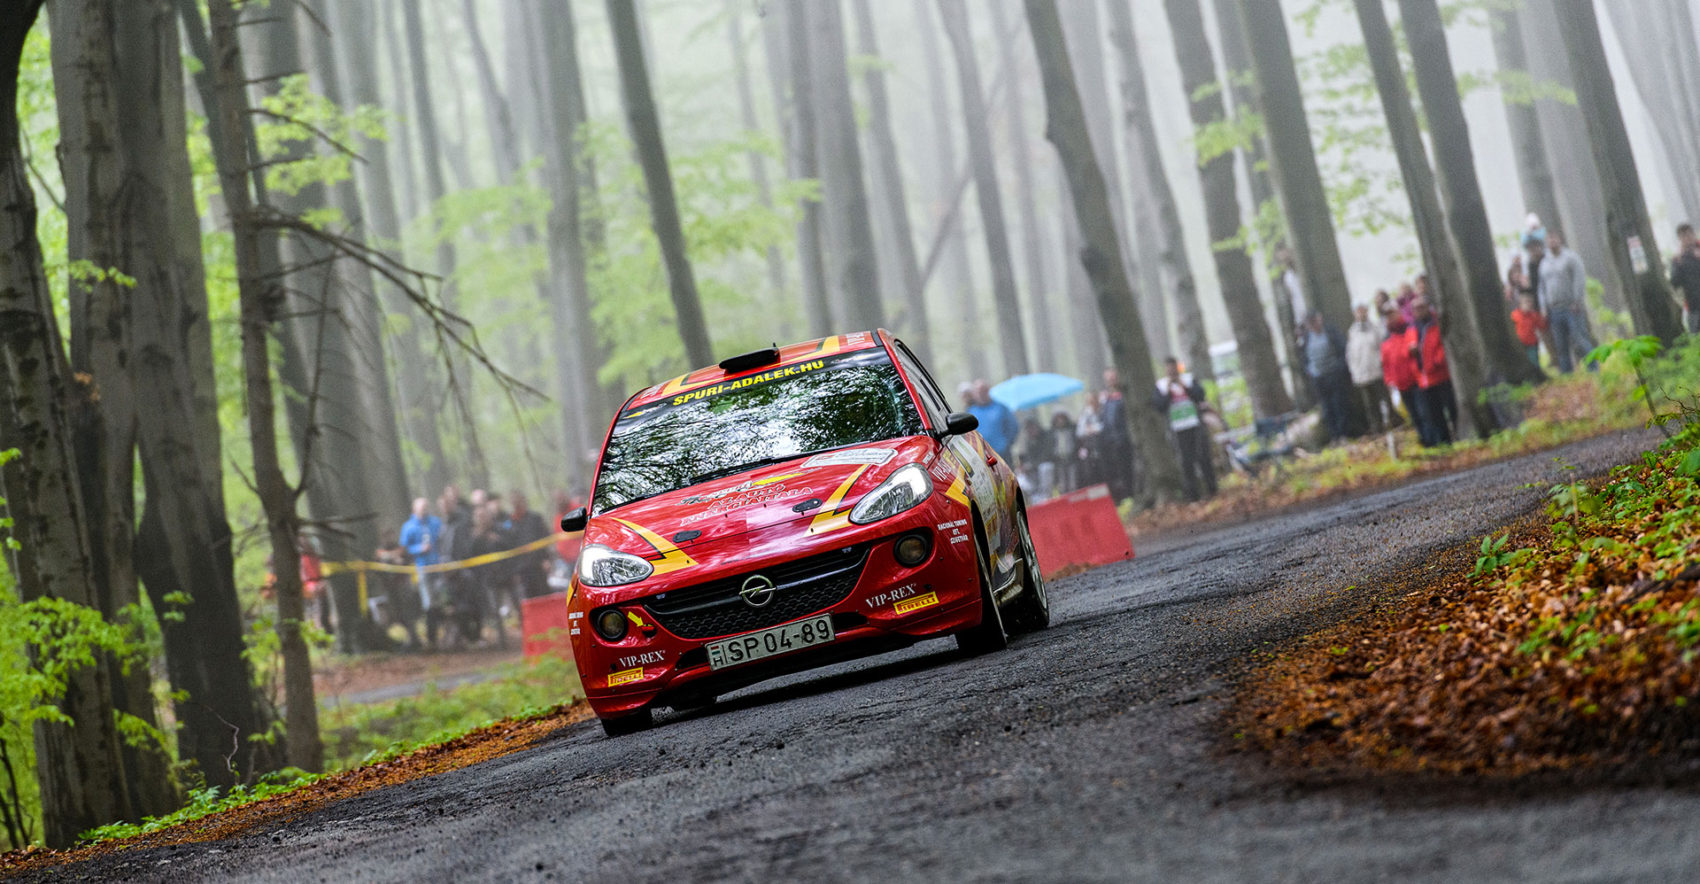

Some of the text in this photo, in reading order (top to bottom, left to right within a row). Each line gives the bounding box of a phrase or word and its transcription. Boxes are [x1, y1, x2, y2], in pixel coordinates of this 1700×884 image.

[672, 360, 824, 406] SPURI-ADALEK.HU
[896, 594, 936, 612] PIRELLI
[713, 656, 724, 667] H
